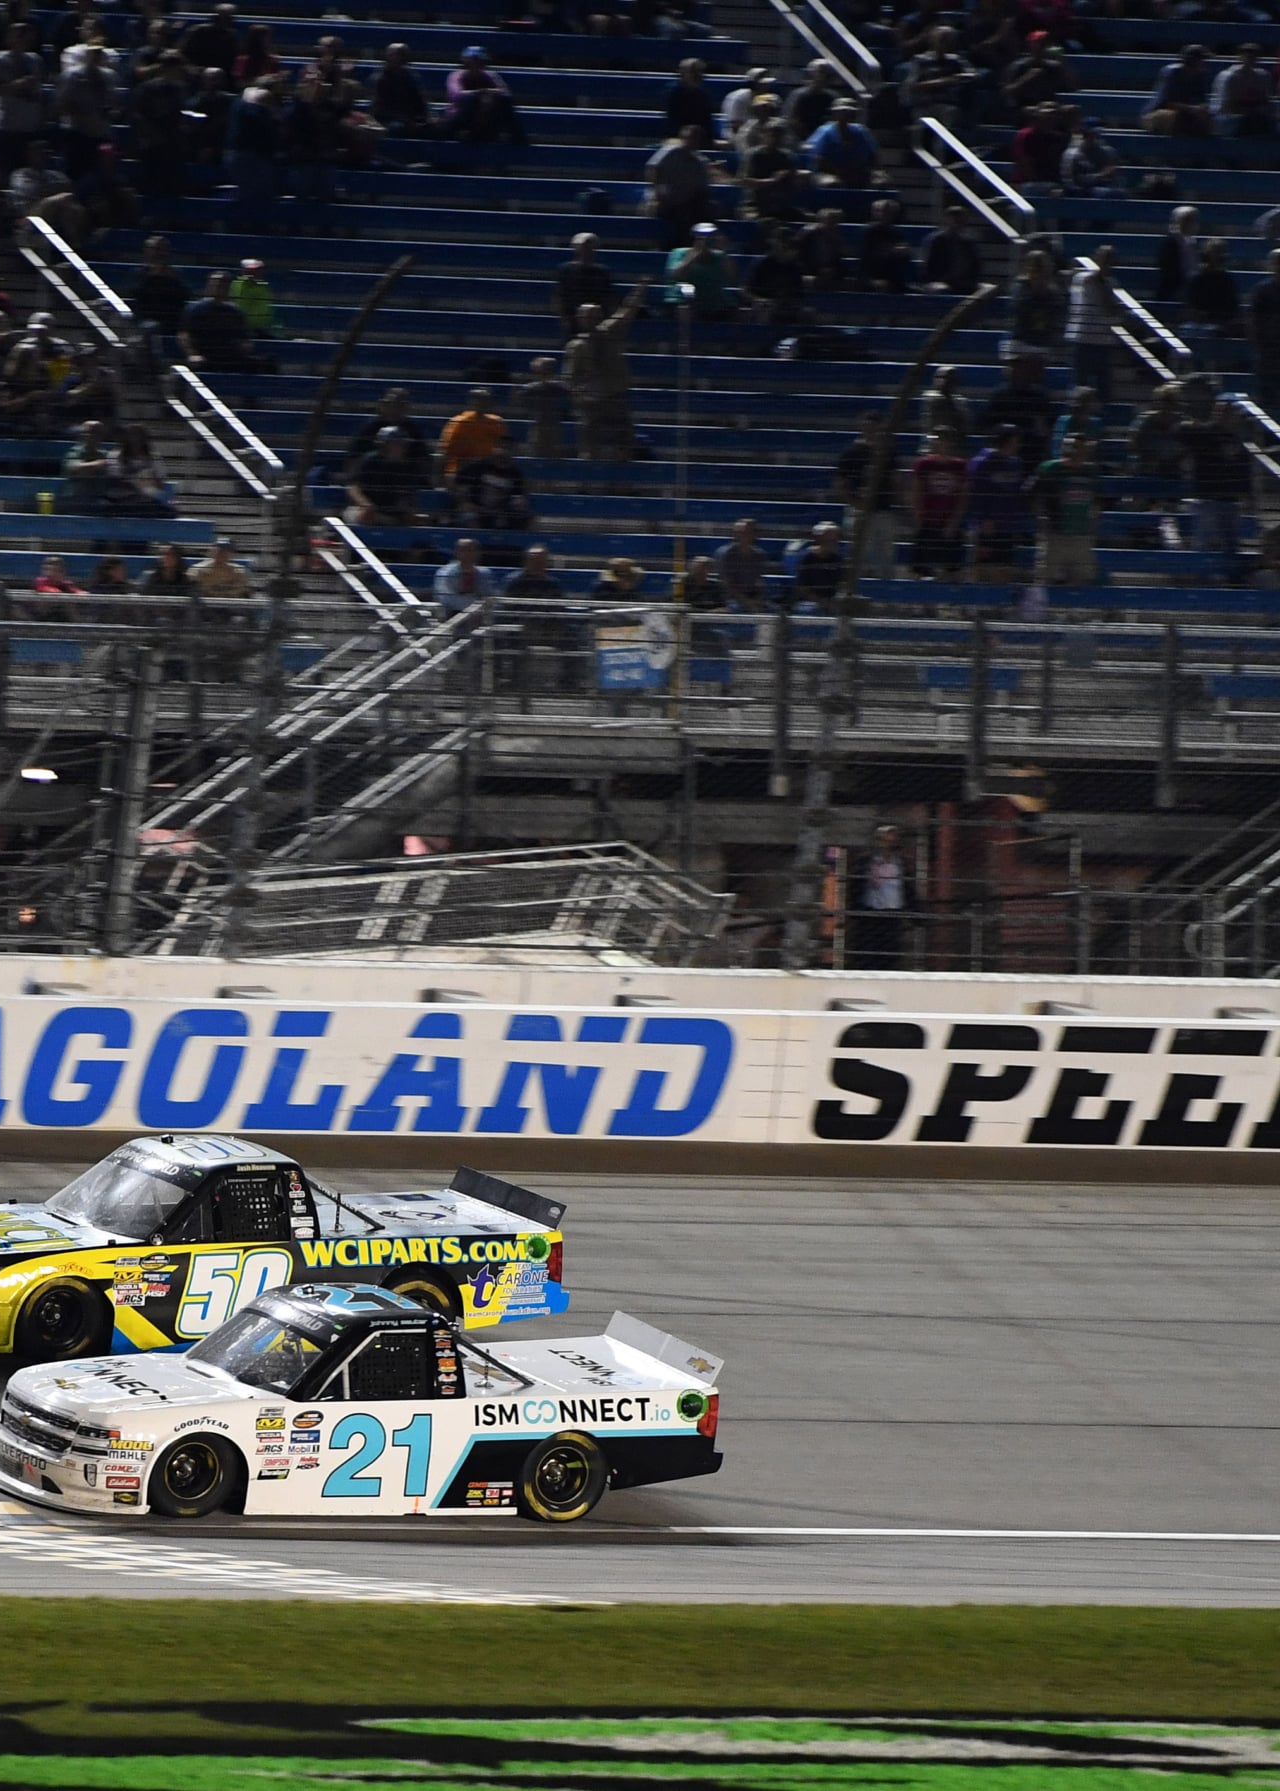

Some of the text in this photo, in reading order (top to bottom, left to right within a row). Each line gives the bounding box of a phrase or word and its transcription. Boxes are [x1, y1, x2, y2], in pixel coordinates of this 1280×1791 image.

[812, 1021, 1280, 1147] SPEE
[300, 1237, 528, 1267] WCIPARTS.COM
[496, 1270, 549, 1286] CARONE
[175, 1247, 293, 1340] 50
[174, 1416, 230, 1432] GOODYEAR
[108, 1450, 147, 1461] MAHLE
[288, 1445, 311, 1453] Mobil
[321, 1412, 432, 1497] 21
